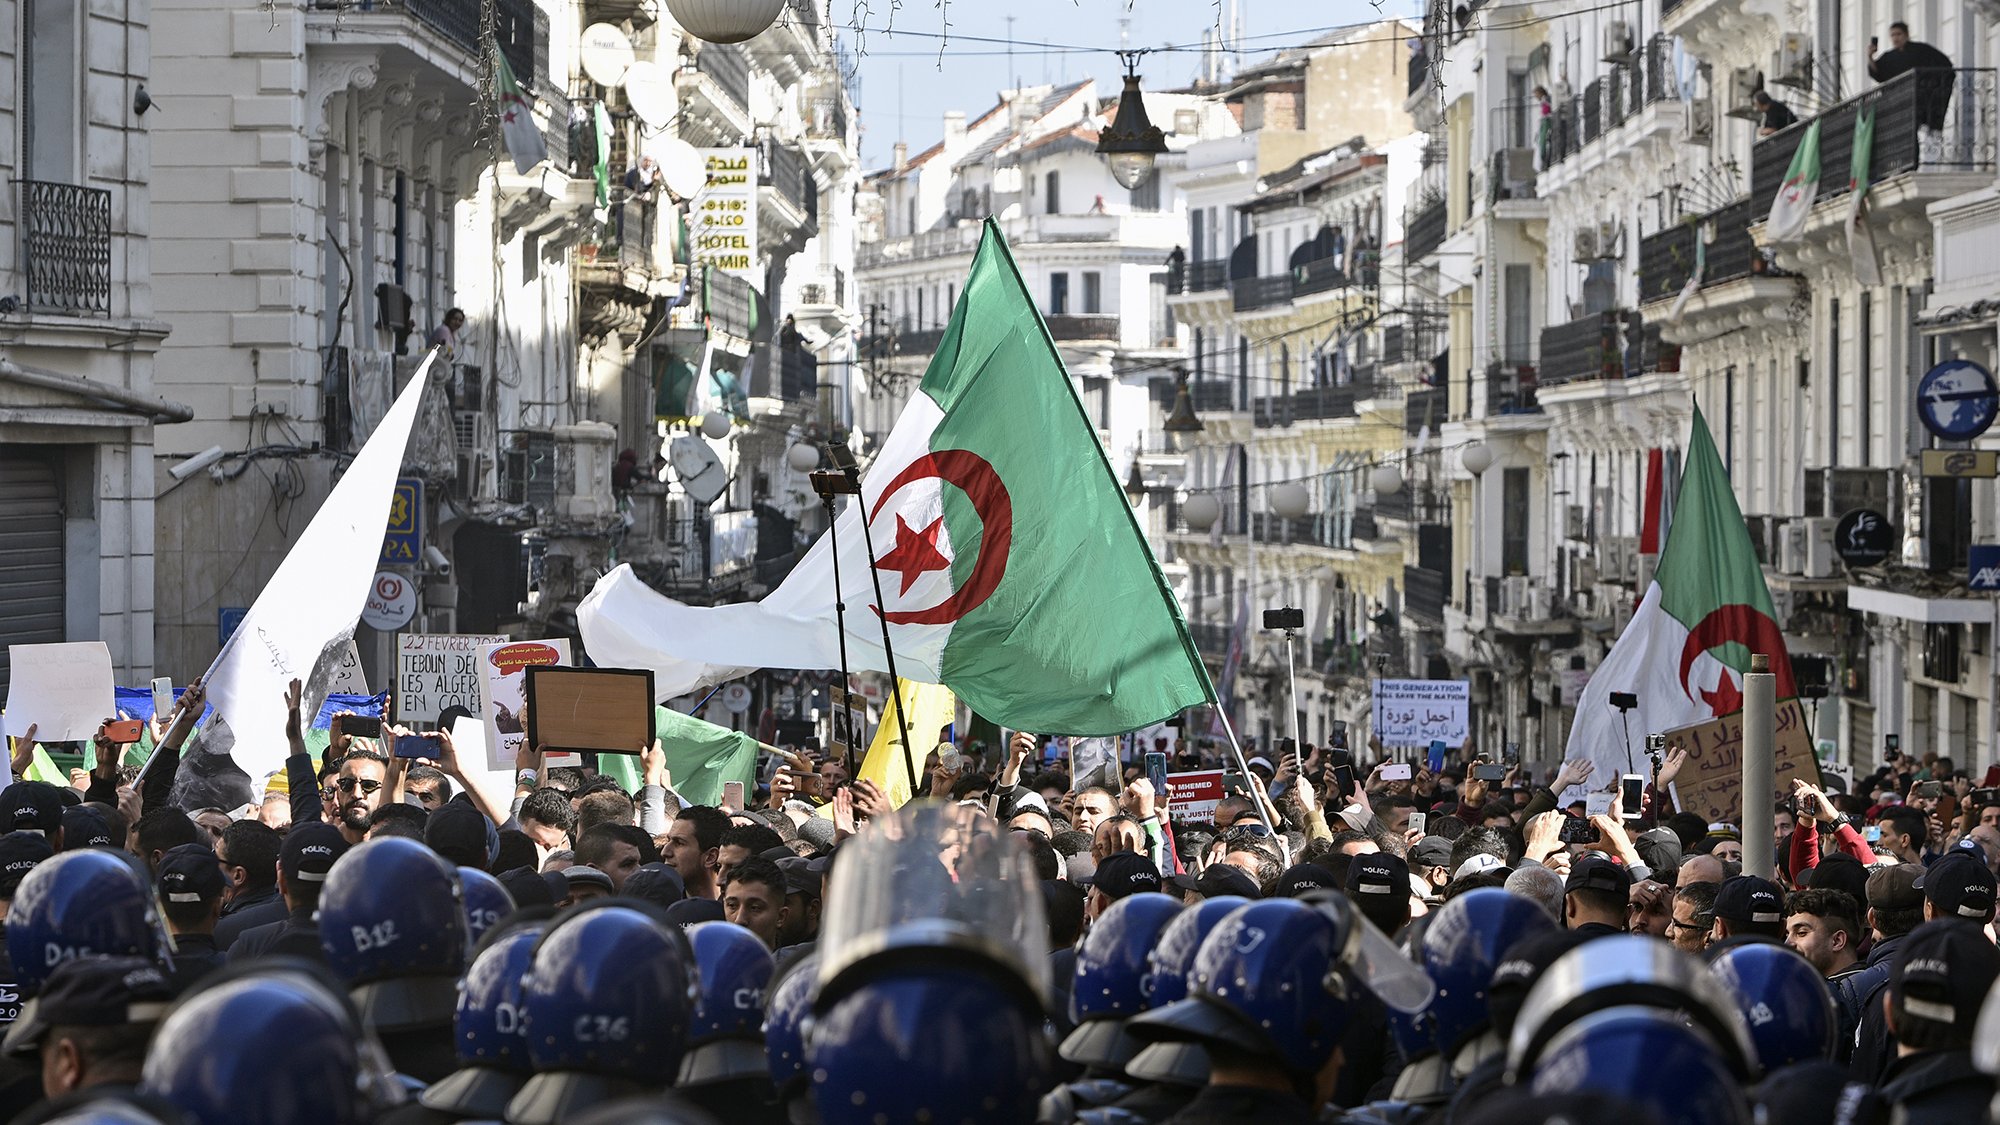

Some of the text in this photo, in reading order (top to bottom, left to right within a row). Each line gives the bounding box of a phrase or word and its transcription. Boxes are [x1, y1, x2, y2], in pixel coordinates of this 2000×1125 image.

[697, 236, 749, 248] HOTEL
[384, 540, 414, 558] PA
[404, 636, 424, 649] 22
[428, 636, 470, 651] FEVRIER
[402, 654, 446, 674] TEBOUN
[402, 675, 423, 693] LES
[1403, 684, 1462, 692] GENERATION
[1433, 692, 1466, 700] NATION
[405, 695, 427, 711] EN
[1386, 708, 1415, 725] ثورة
[1177, 781, 1212, 790] MHEMED
[1171, 791, 1195, 799] LHADI
[14, 807, 39, 817] POLICE
[302, 846, 332, 856] POLICE
[5, 861, 39, 873] POLICE
[1481, 857, 1500, 867] LA
[1362, 867, 1391, 876] POLICE
[1964, 885, 1990, 895] POLICE
[1752, 891, 1775, 900] POLICE
[351, 919, 399, 952] B12
